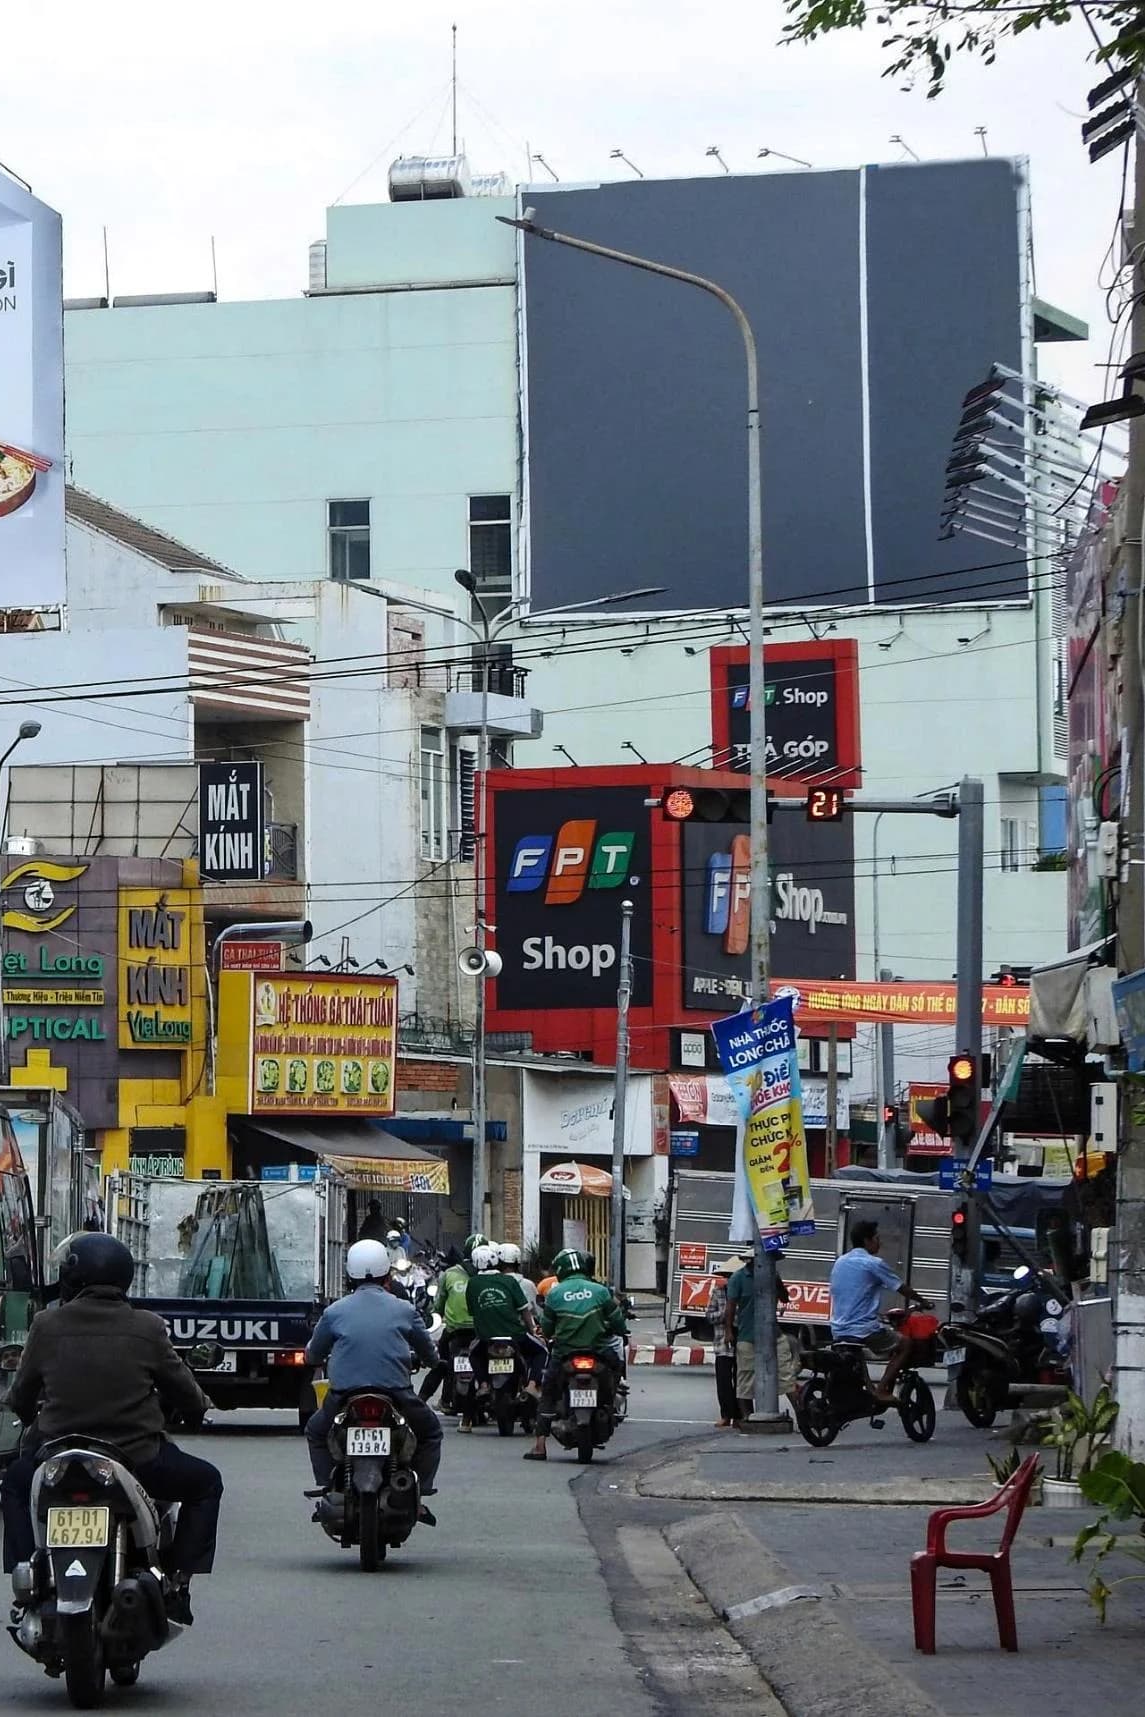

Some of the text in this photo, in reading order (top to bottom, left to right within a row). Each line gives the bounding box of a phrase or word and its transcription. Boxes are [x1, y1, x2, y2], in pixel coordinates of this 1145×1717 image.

[783, 687, 828, 707] Shop
[783, 735, 829, 758] GÓP
[208, 769, 250, 821] MẮT
[812, 791, 838, 816] 21
[205, 825, 253, 870] KÍNH
[775, 873, 823, 934] Shop
[129, 894, 186, 950] MẮT
[40, 946, 103, 978] Long
[523, 935, 615, 976] Shop
[127, 957, 189, 1006] KÍNH
[890, 992, 910, 1012] DÂN
[912, 990, 925, 1012] SỐ
[926, 991, 945, 1012] THẾ
[947, 999, 956, 1013] GI
[995, 995, 1015, 1014] DÂN
[3, 1016, 106, 1040] PTICAL
[729, 1032, 754, 1049] NHÀ
[729, 1032, 790, 1067] LONG CHÂ
[749, 1154, 772, 1166] GIẢM
[563, 1288, 593, 1301] Grab
[51, 1528, 103, 1544] 467.94
